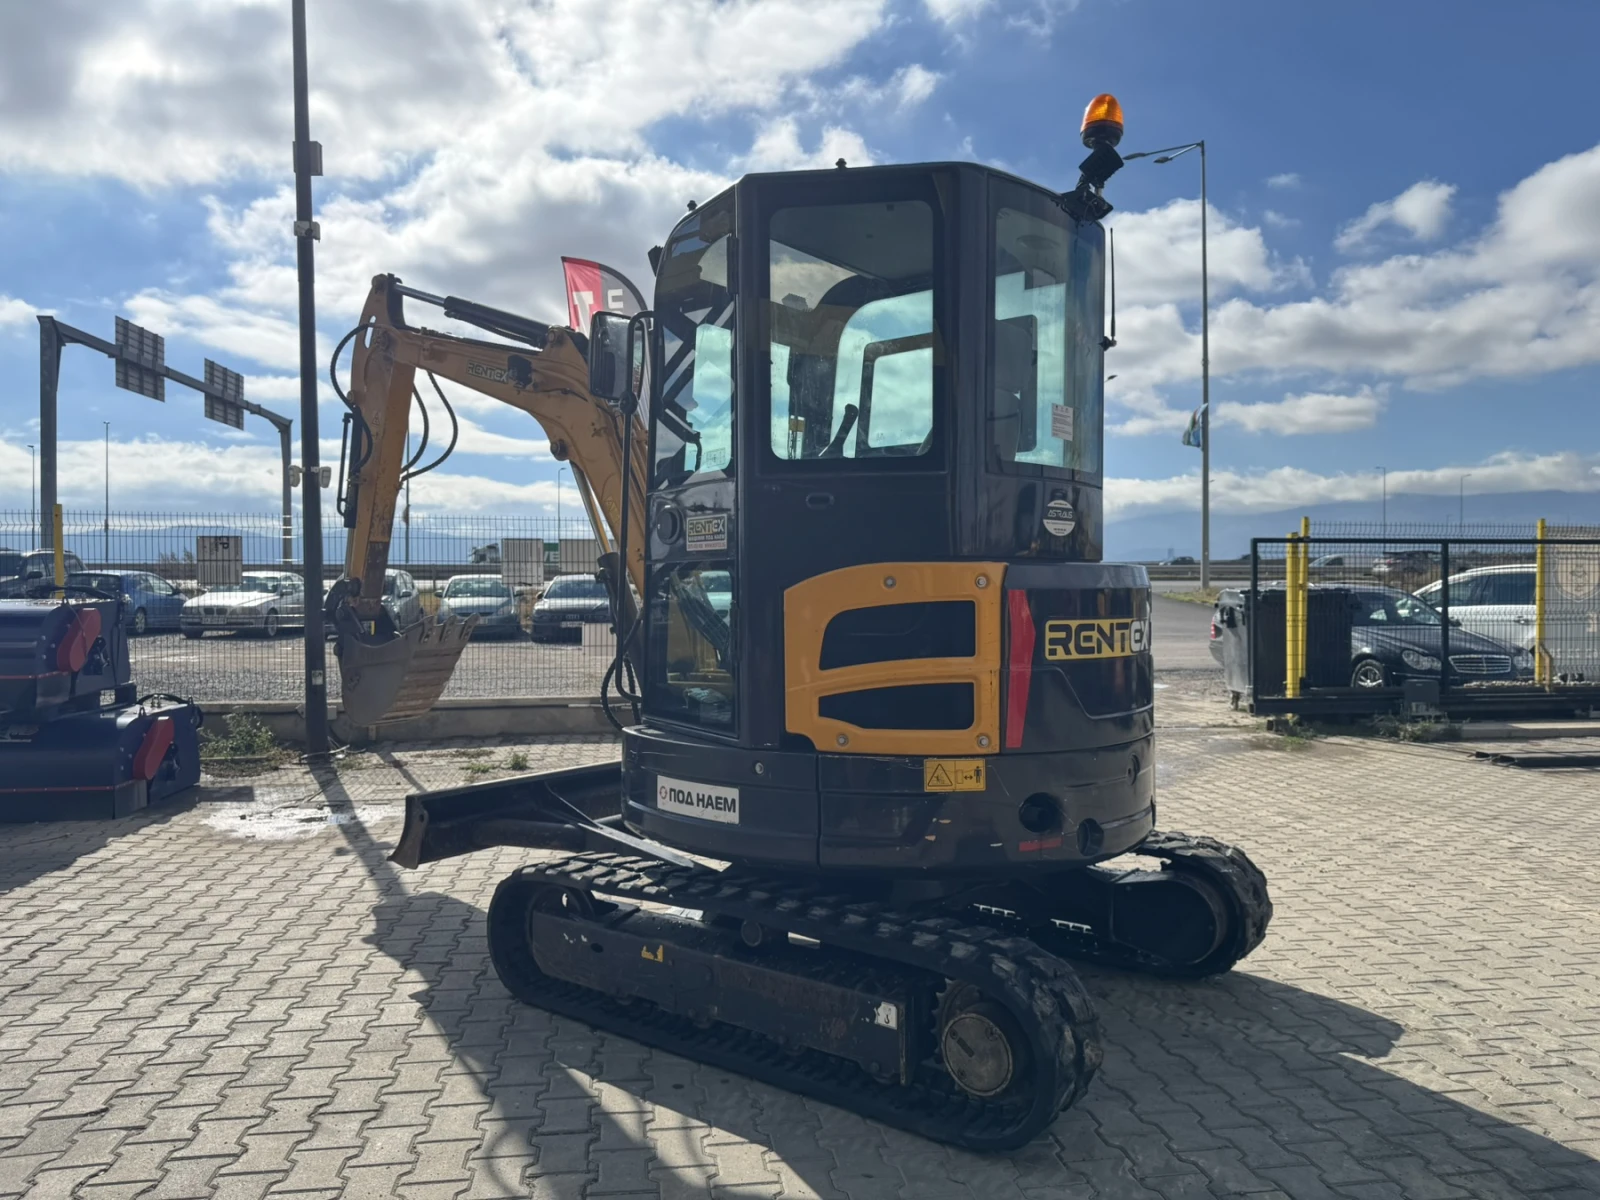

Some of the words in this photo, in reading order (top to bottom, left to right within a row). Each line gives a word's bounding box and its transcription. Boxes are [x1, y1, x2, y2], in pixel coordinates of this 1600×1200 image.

[467, 361, 507, 383] RENTEX
[689, 519, 724, 534] RENTEX
[1048, 621, 1149, 656] RENTEX
[669, 788, 694, 806] ПОД
[696, 793, 736, 813] НАЕМ
